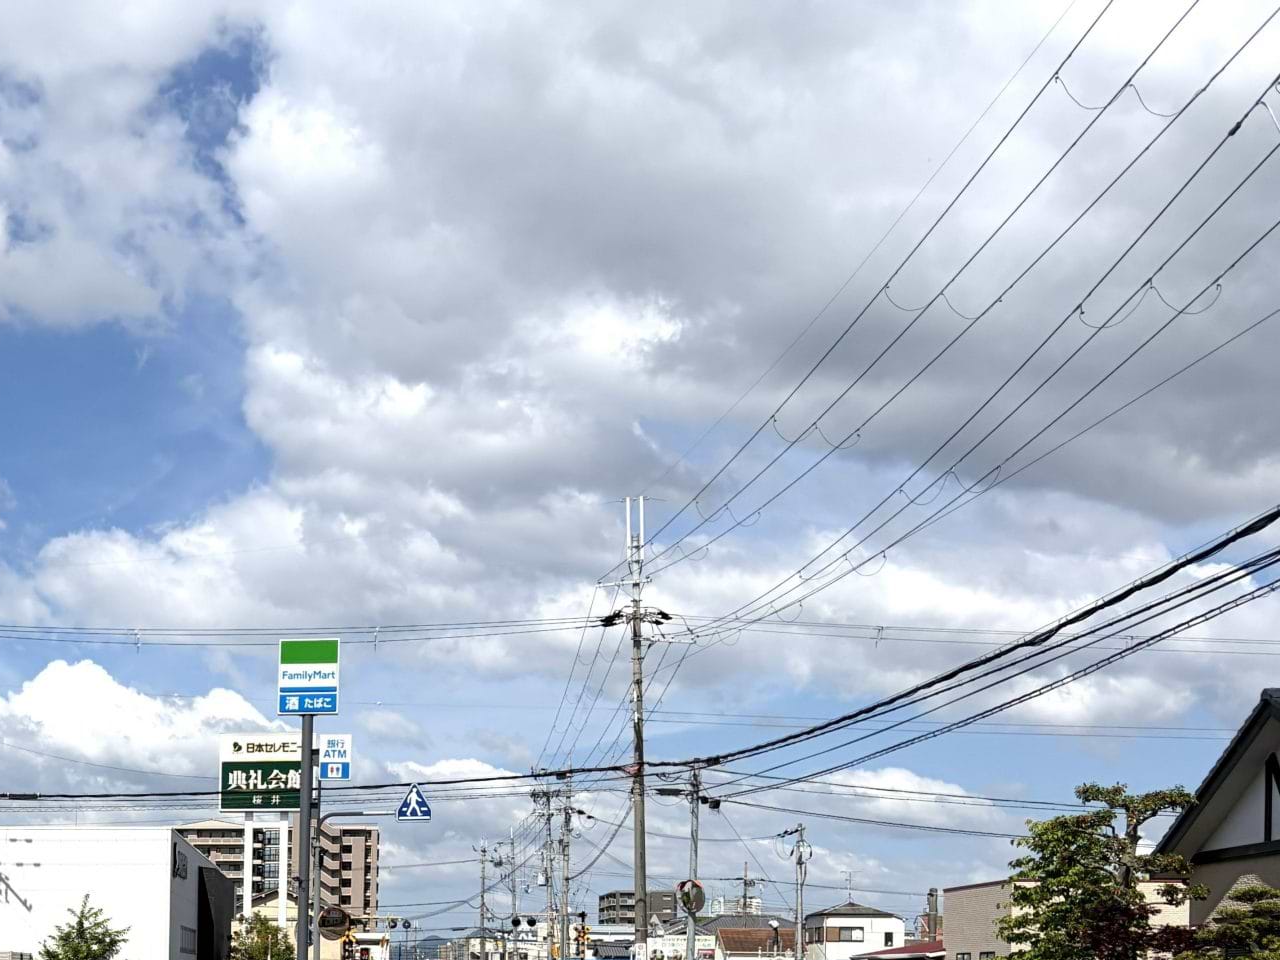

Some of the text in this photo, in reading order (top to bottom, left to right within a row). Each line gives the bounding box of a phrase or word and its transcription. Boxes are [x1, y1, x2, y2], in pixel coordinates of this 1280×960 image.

[282, 670, 335, 681] FamilyMart
[285, 696, 332, 710] 酒 たばこ
[327, 739, 345, 748] 銀行
[323, 749, 347, 758] ATM
